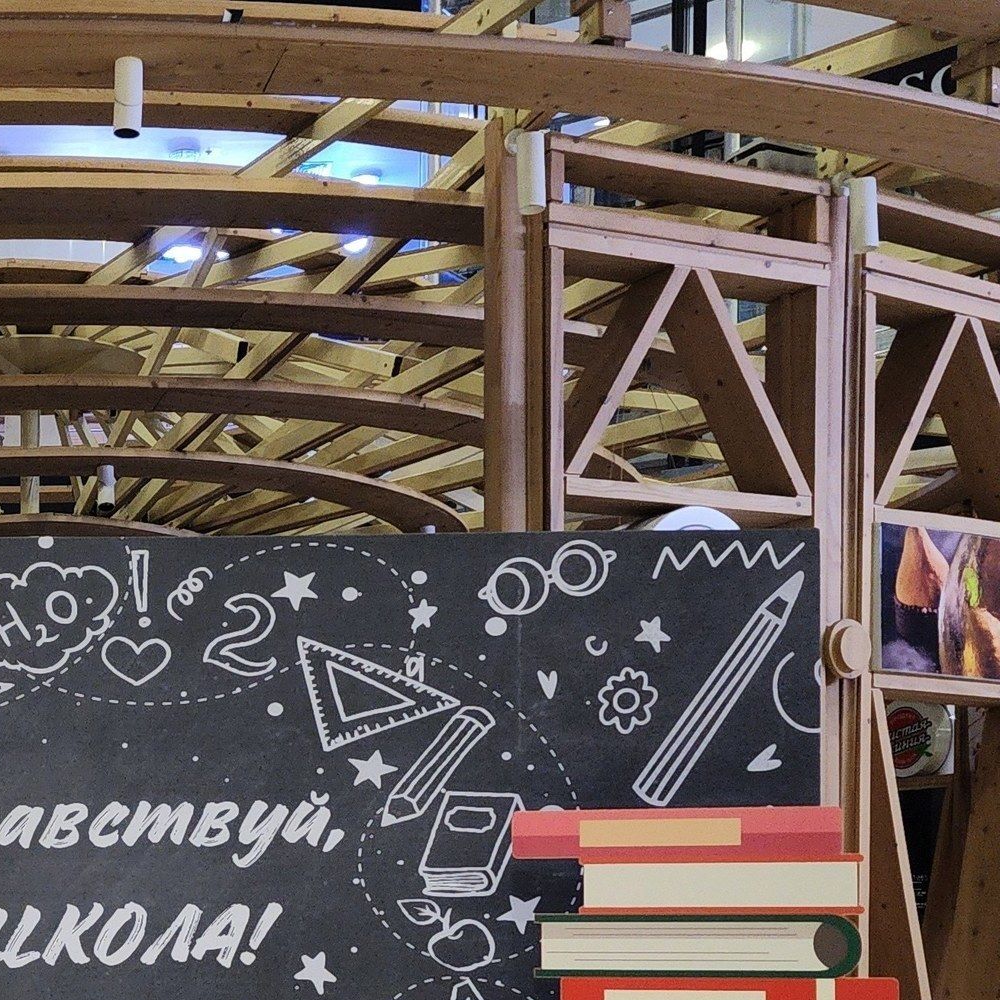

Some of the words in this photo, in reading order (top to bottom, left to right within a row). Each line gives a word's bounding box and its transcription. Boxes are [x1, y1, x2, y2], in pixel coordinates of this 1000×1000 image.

[203, 593, 277, 677] 2
[889, 718, 932, 741] истая
[892, 733, 931, 753] иния
